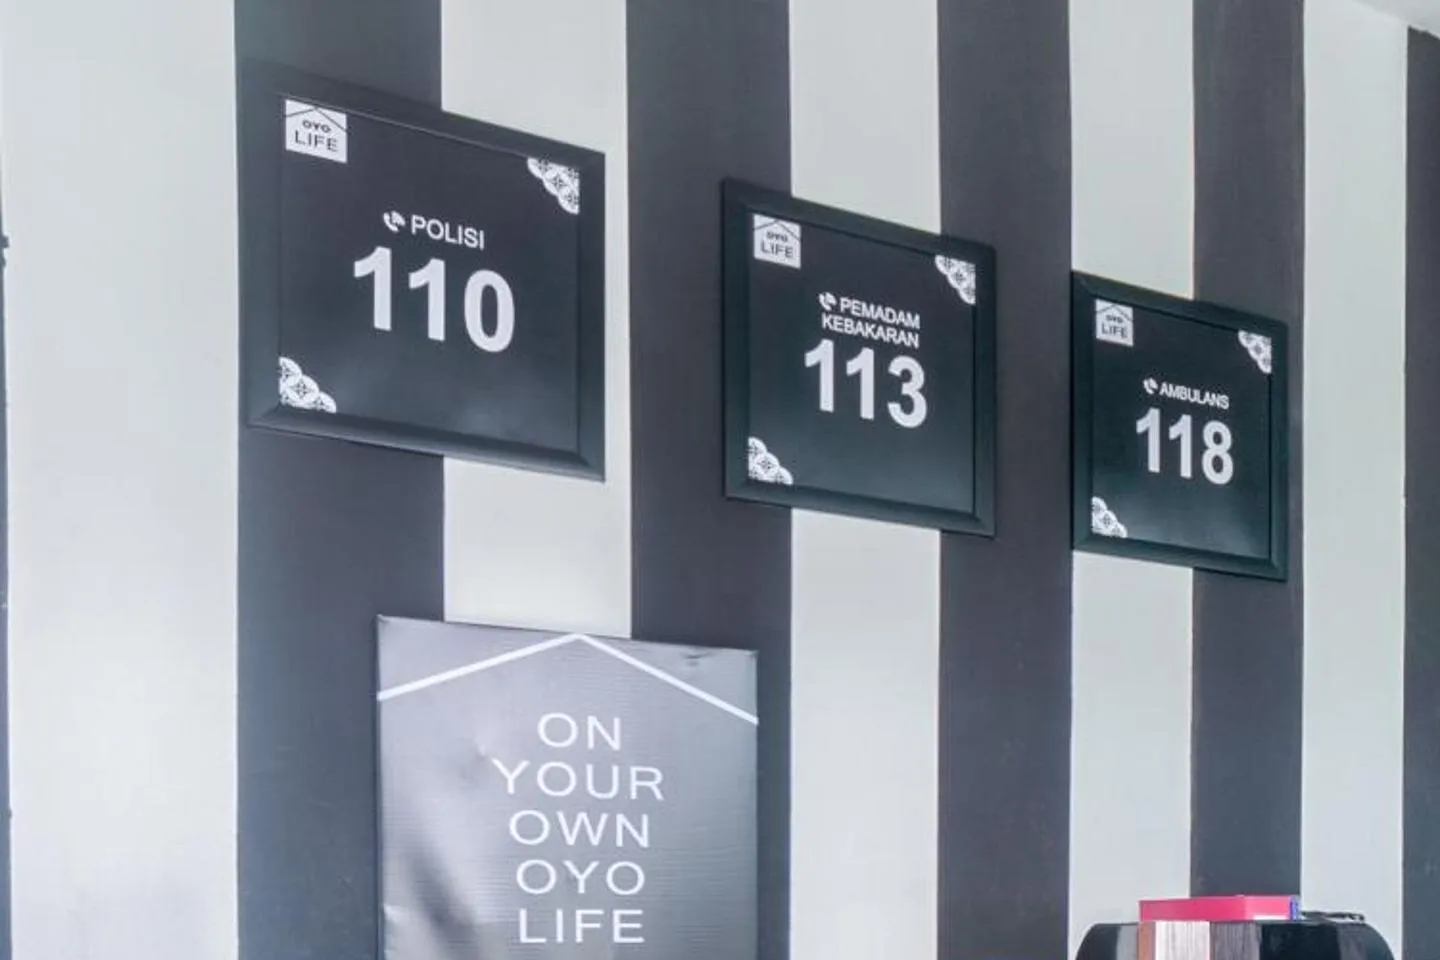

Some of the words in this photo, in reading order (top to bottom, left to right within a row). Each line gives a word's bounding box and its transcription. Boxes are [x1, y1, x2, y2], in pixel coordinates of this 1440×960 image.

[295, 129, 339, 153] LIFE
[302, 119, 332, 134] OYO
[410, 214, 485, 251] POLISI
[760, 239, 794, 259] LIFE
[353, 246, 515, 352] 110
[821, 312, 919, 349] KEBAKARAN
[1101, 323, 1128, 339] LIFE
[804, 338, 928, 428] 113
[1158, 381, 1230, 410] AMBULANS
[1135, 407, 1234, 485] 118
[537, 712, 622, 751] ON
[491, 757, 665, 801] YOUR
[508, 809, 649, 848] OWN
[516, 859, 646, 896] OYO
[518, 908, 645, 944] LIFE
